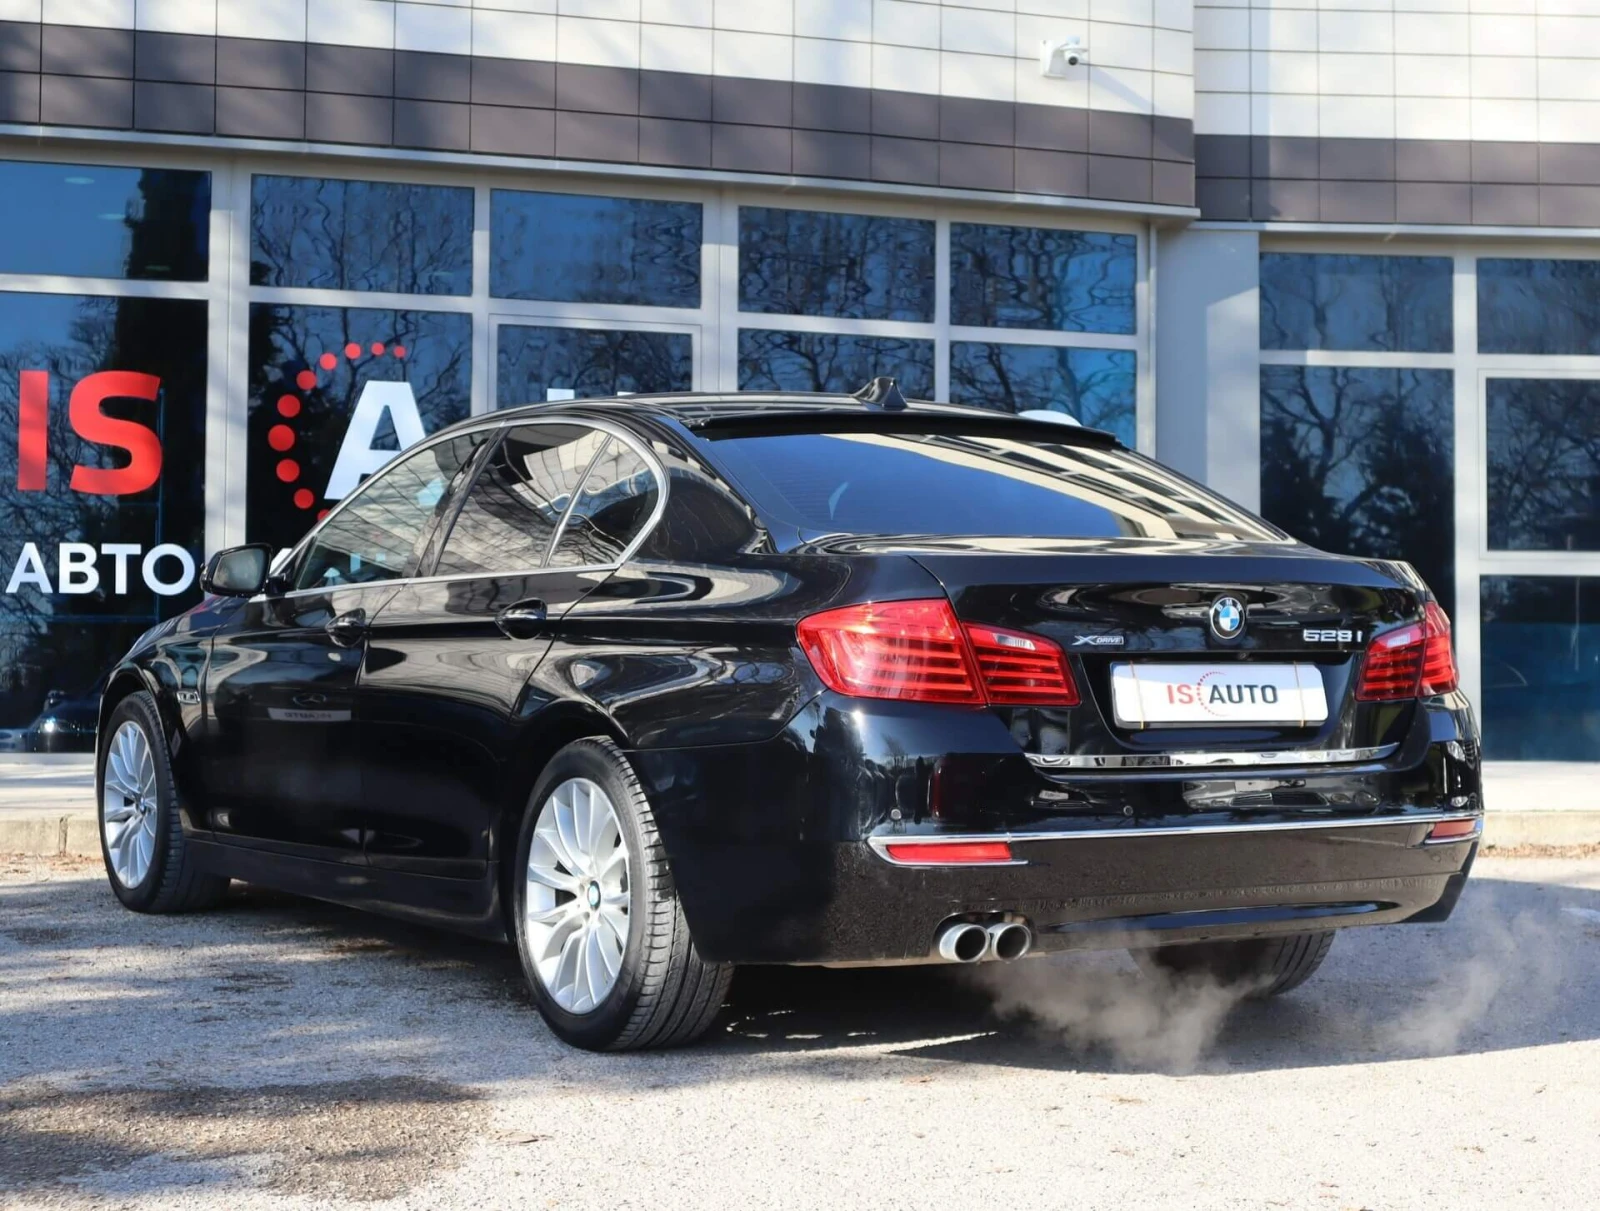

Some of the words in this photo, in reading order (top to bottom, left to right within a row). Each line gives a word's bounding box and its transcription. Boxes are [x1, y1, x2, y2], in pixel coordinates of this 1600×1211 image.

[17, 370, 163, 495] IS
[1167, 684, 1194, 704] IS
[1209, 684, 1278, 704] AUTO
